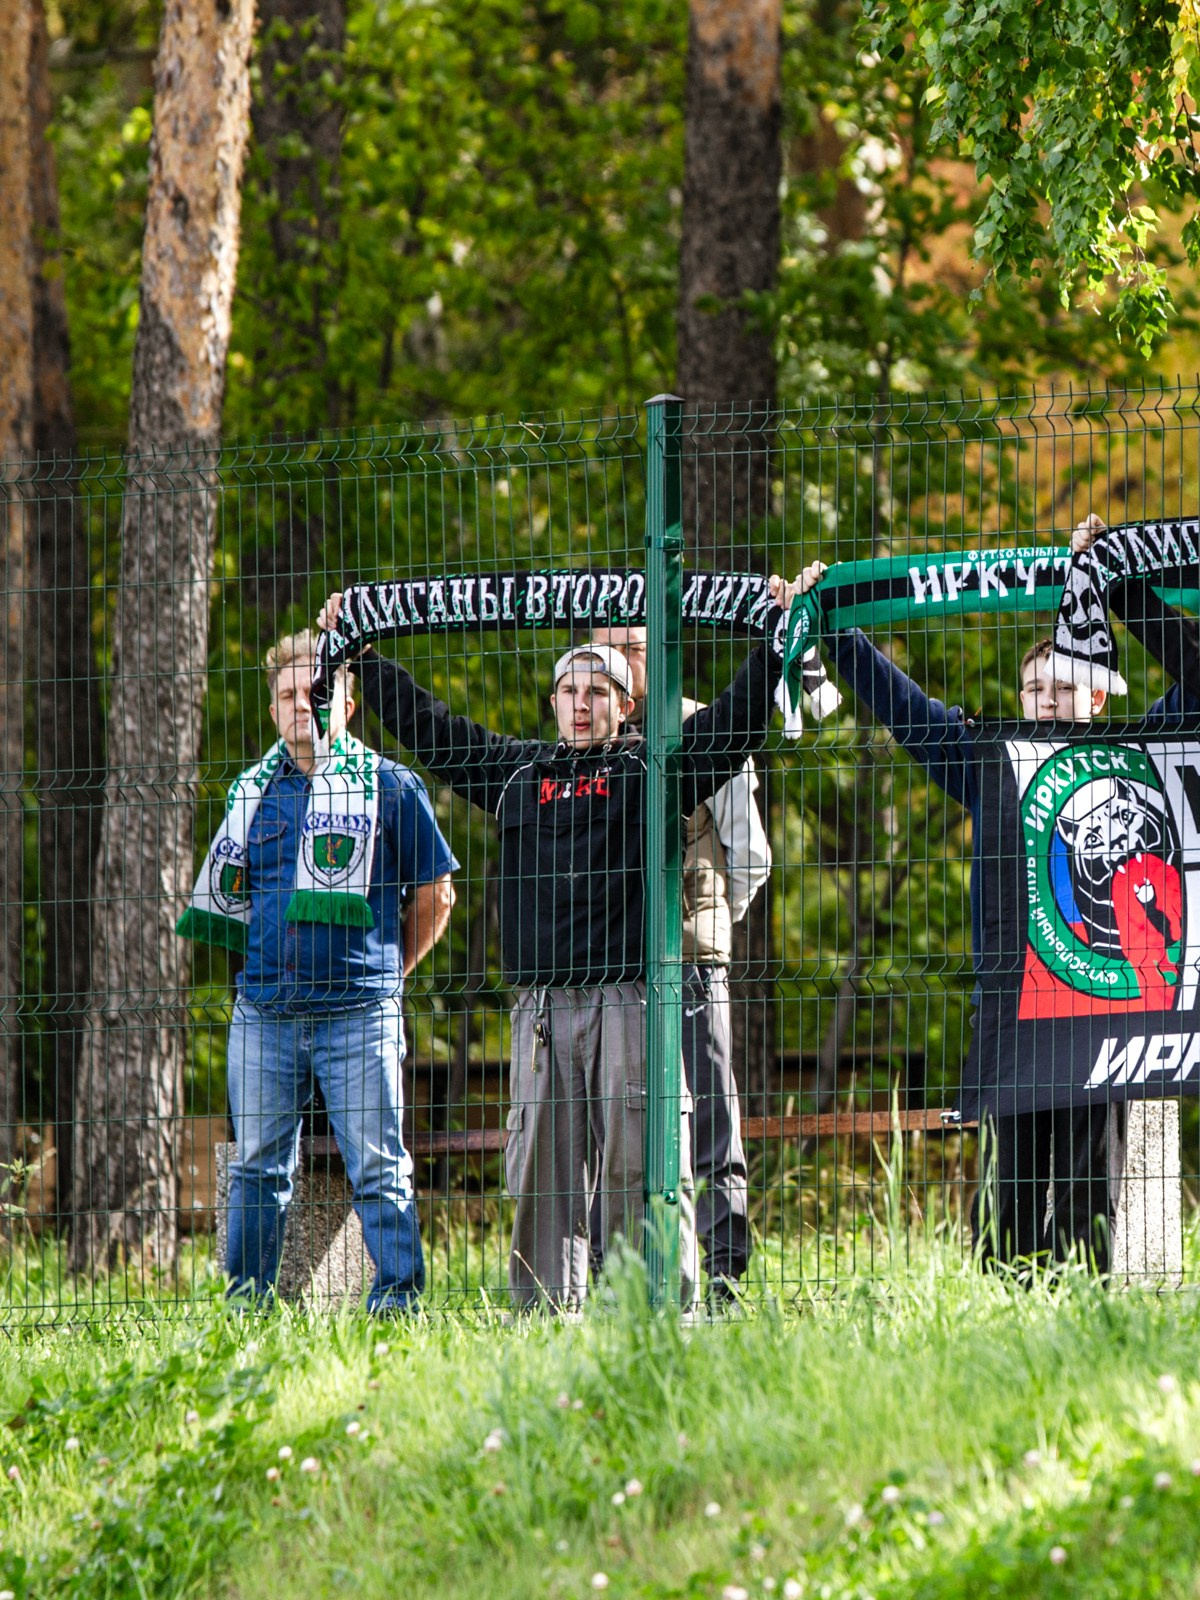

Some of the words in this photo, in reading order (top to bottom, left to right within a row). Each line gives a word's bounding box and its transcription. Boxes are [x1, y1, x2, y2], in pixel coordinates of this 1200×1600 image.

[525, 573, 647, 620] ВТОРО
[908, 557, 1071, 604] ИРКУТ
[1024, 750, 1131, 832] ИРКУТСК
